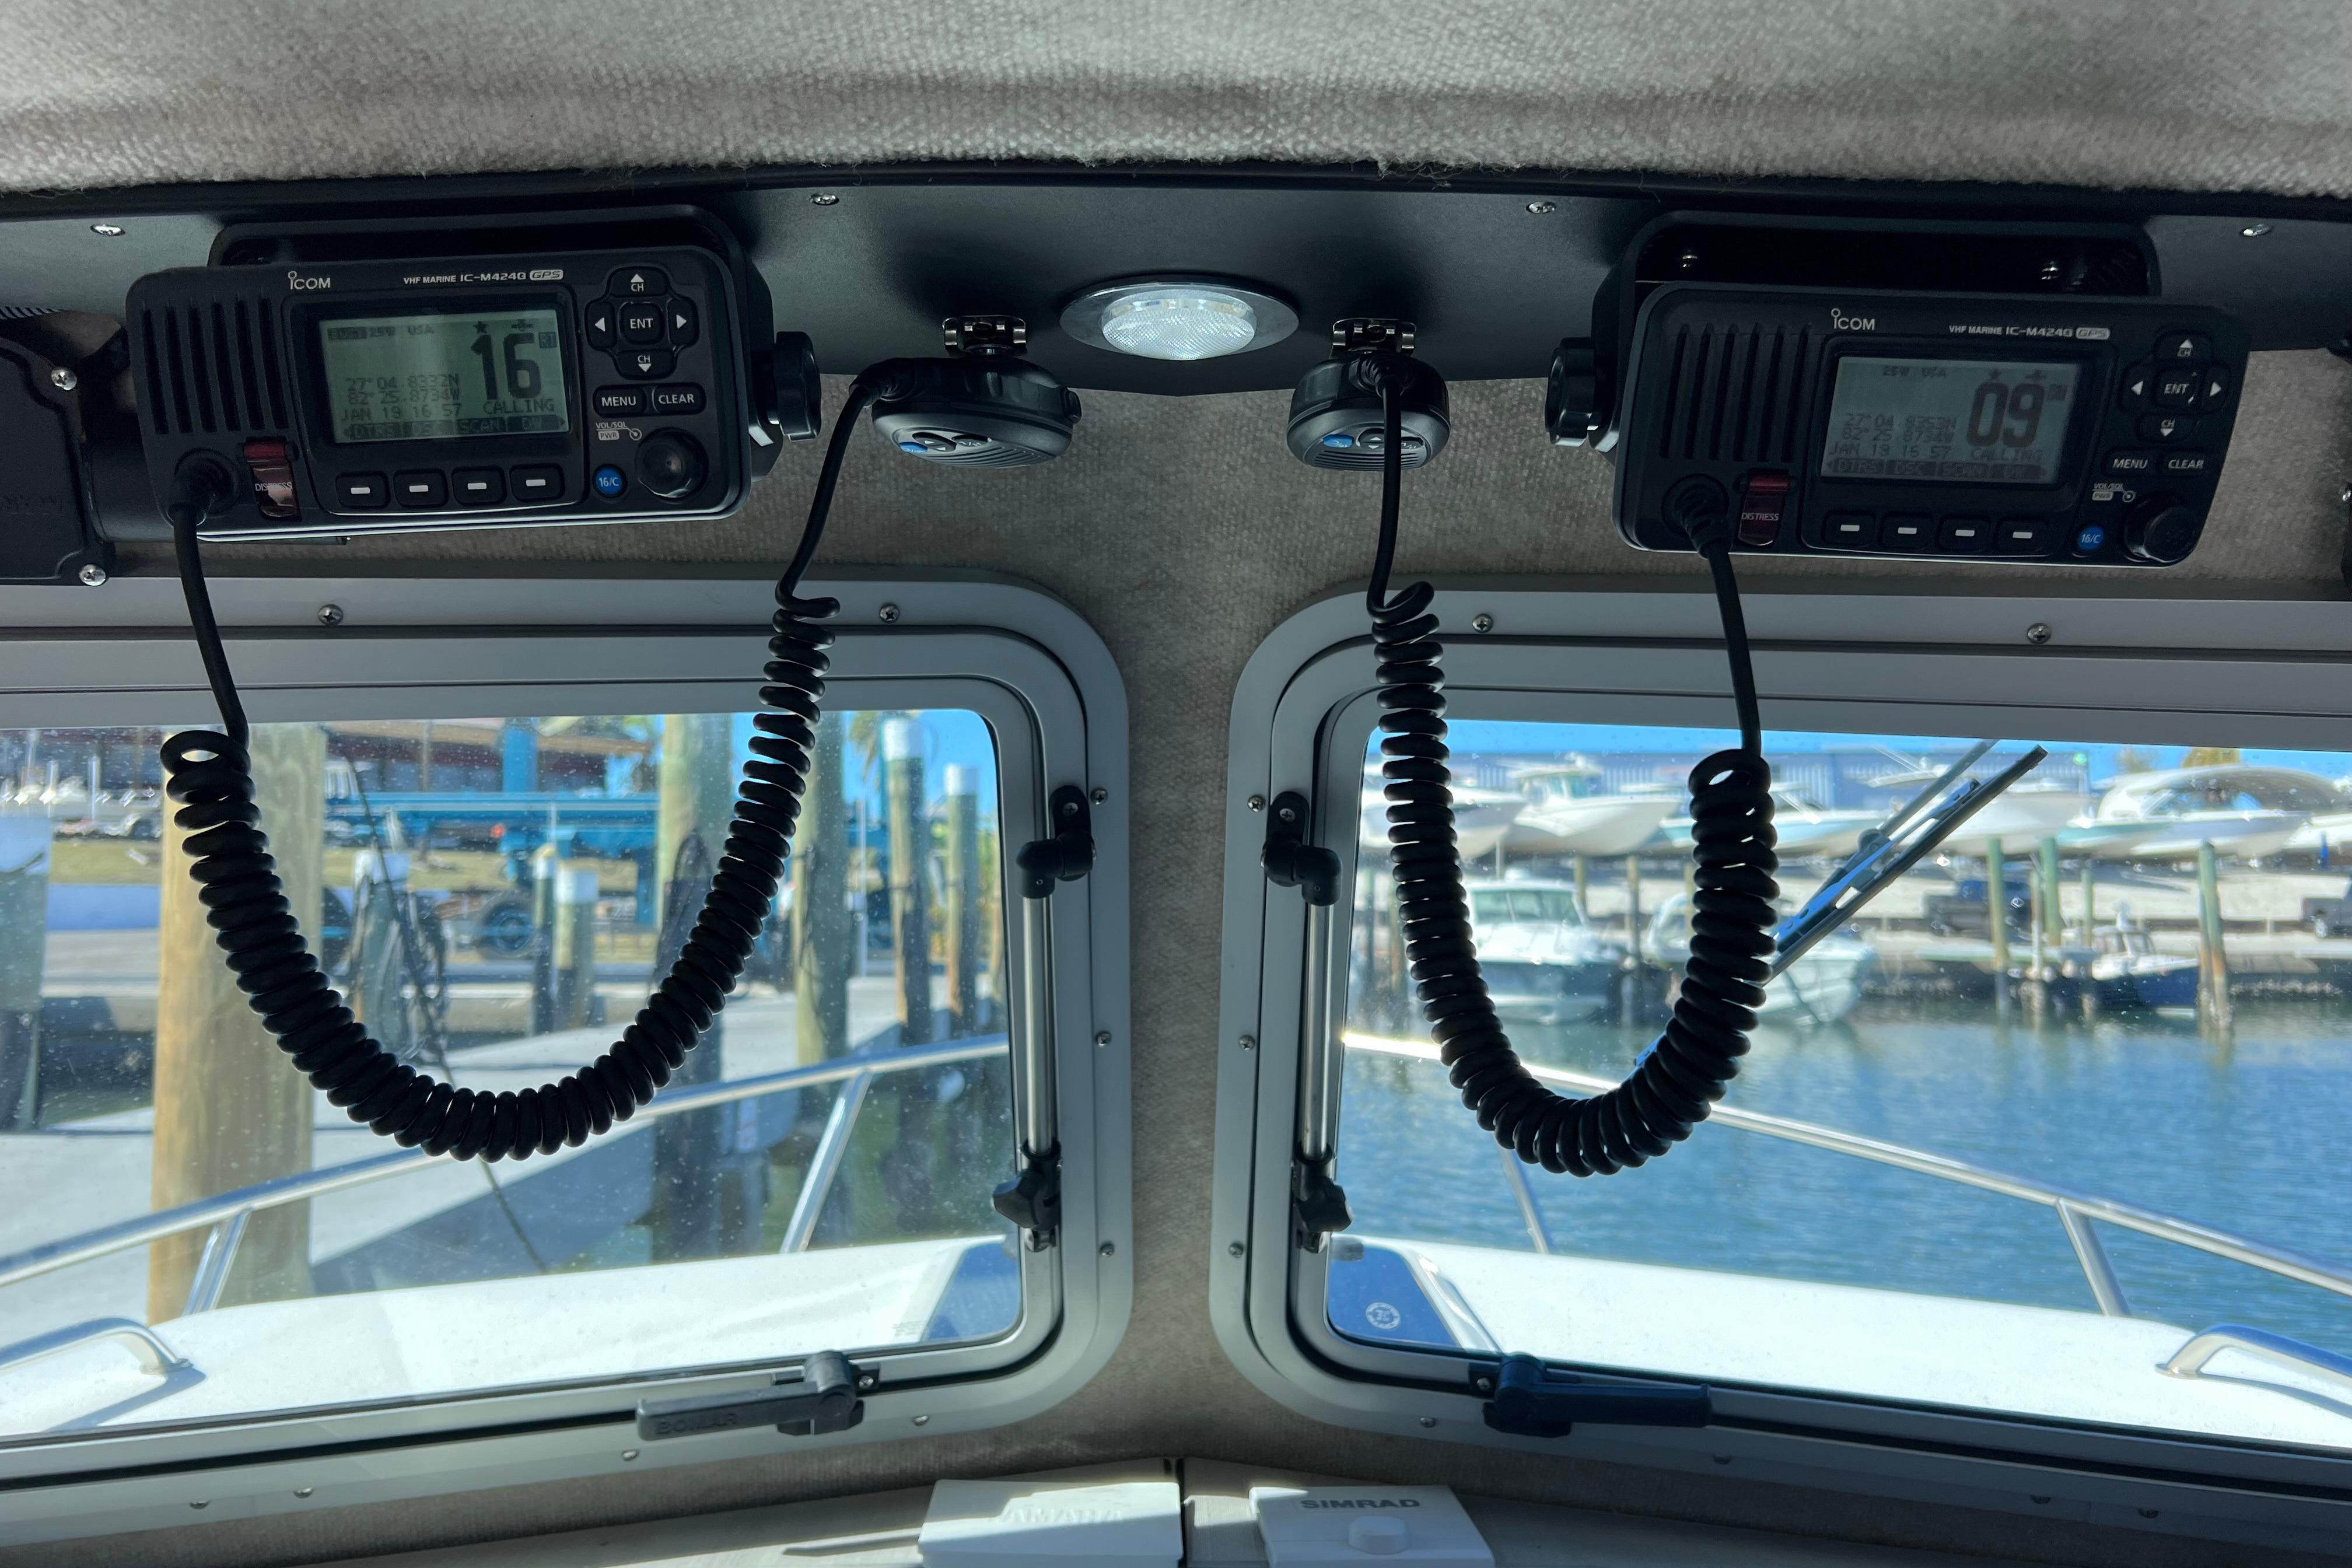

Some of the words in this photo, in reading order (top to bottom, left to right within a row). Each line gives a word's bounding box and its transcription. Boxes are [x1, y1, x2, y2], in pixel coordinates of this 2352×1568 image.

[404, 276, 421, 285] VHF
[422, 275, 456, 284] MARINE
[532, 271, 561, 280] GPS
[631, 283, 645, 292] CH
[630, 317, 654, 329] ENT
[1949, 326, 1966, 334] VHF
[1968, 326, 2003, 335] MARINE
[2177, 348, 2192, 357] CH
[638, 355, 650, 363] CH
[470, 332, 542, 400] 16
[2164, 383, 2189, 394] ENT
[601, 396, 636, 407] MENU
[658, 393, 694, 404] CLEAR
[482, 398, 555, 415] CALLING
[341, 408, 372, 422] JAN
[1966, 382, 2045, 447] 09
[595, 421, 628, 429] VOL/SQL
[2161, 419, 2175, 428] CH
[1971, 448, 2043, 463] CALLING
[2113, 459, 2149, 469] MENU
[2168, 459, 2204, 470] CLEAR
[598, 476, 620, 488] 16/C
[1741, 512, 1780, 521] DISTRESS
[2081, 534, 2101, 544] 16/C
[1300, 1499, 1419, 1508] SIMRAD
[988, 1506, 1123, 1524] AMAHA
